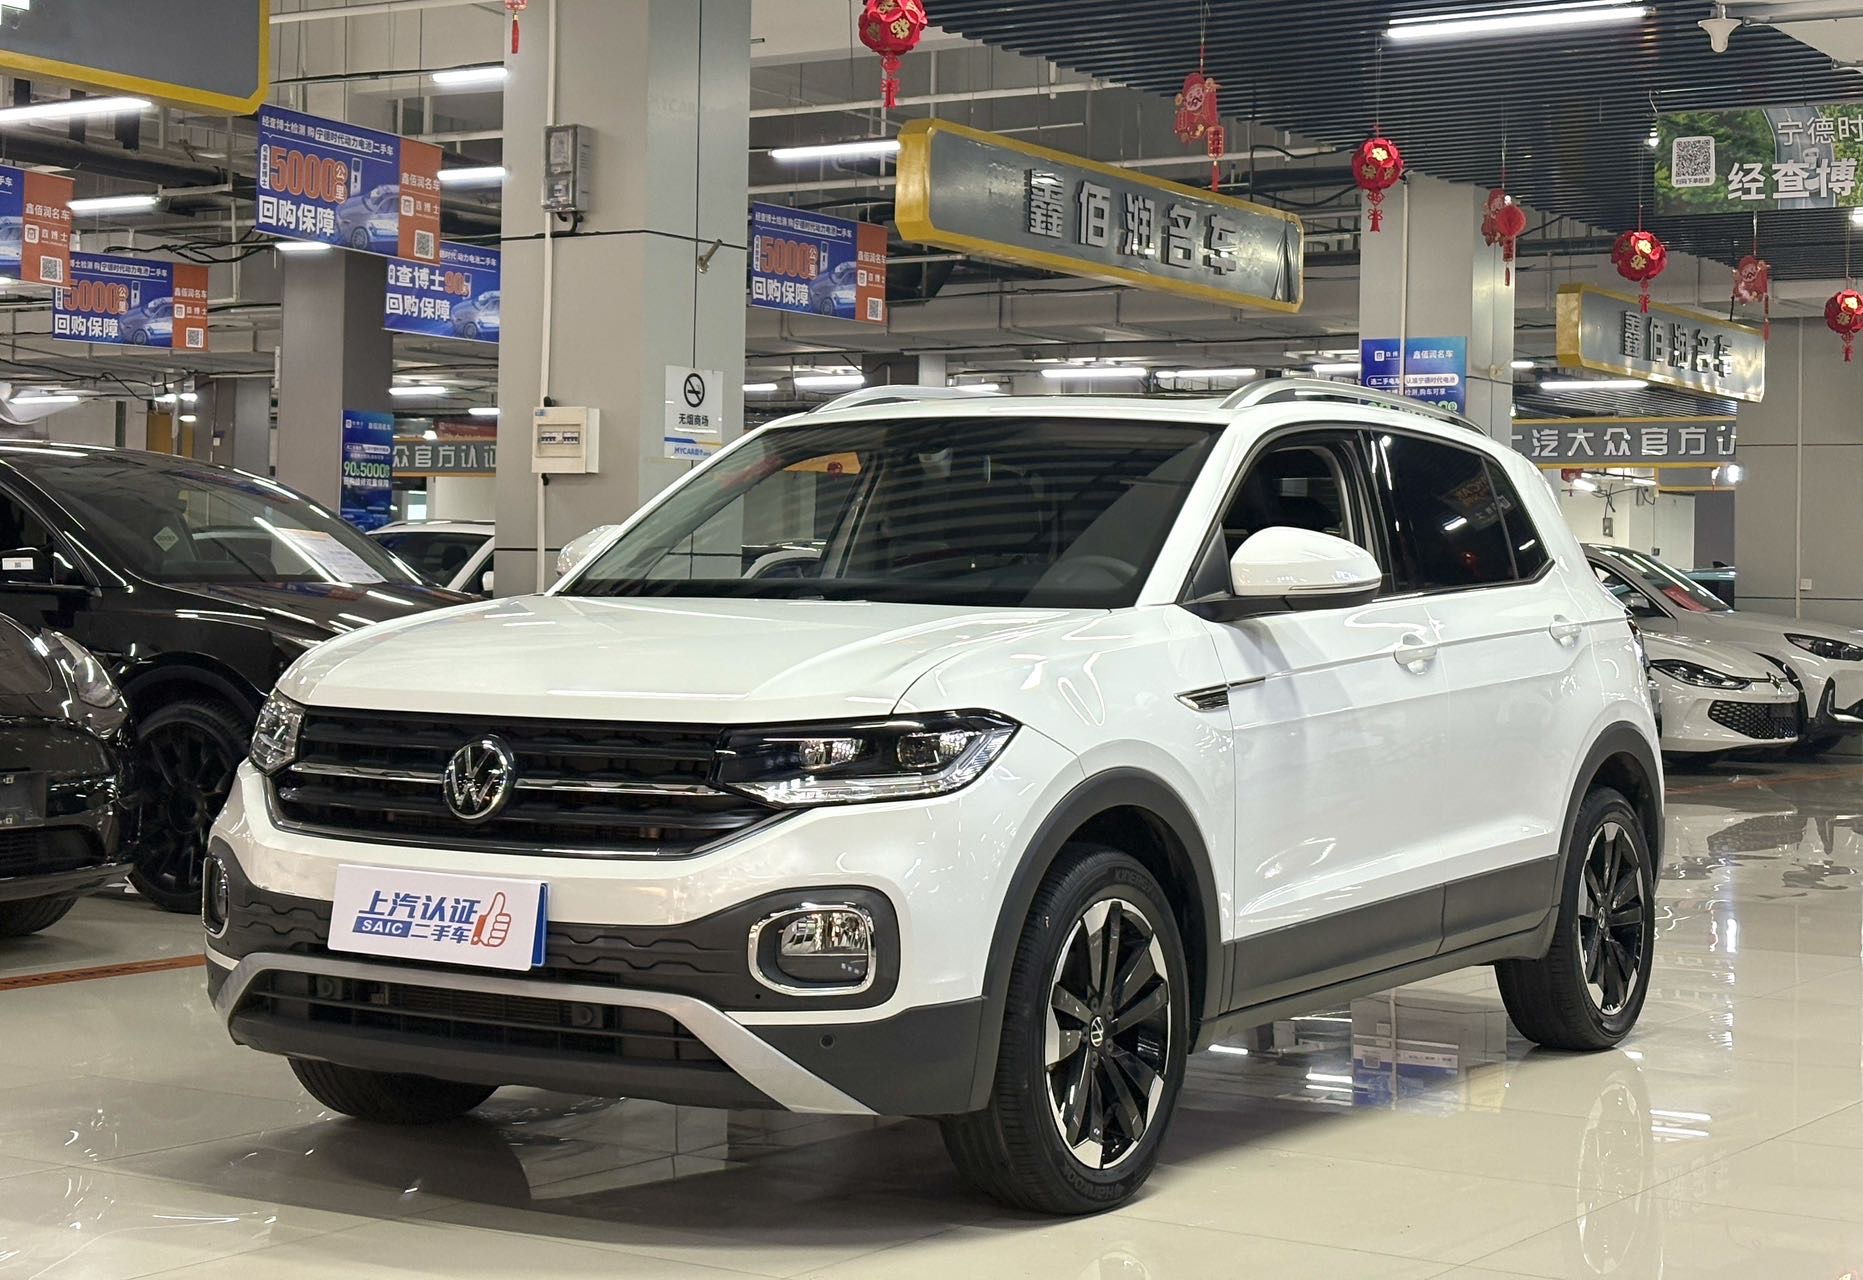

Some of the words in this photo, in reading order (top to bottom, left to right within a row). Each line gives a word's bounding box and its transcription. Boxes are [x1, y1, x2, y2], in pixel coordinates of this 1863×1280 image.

[270, 146, 336, 204] 5000
[401, 172, 440, 192] 鑫佰润名车
[1727, 157, 1858, 201] 经查博
[25, 203, 70, 222] 鑫佰润名车
[258, 195, 335, 237] 回购保障
[1026, 168, 1238, 276] 鑫佰润名车
[761, 236, 809, 279] 5000
[63, 279, 119, 314] 5000
[386, 293, 451, 321] 回购保障
[753, 275, 809, 307] 回购保障
[54, 314, 120, 339] 回购保障
[1623, 310, 1734, 379] 鑫佰润名车
[679, 413, 709, 427] 无烟商场
[358, 890, 482, 924] 上汽认证
[361, 919, 404, 935] SAIC
[411, 923, 473, 944] 二手车
